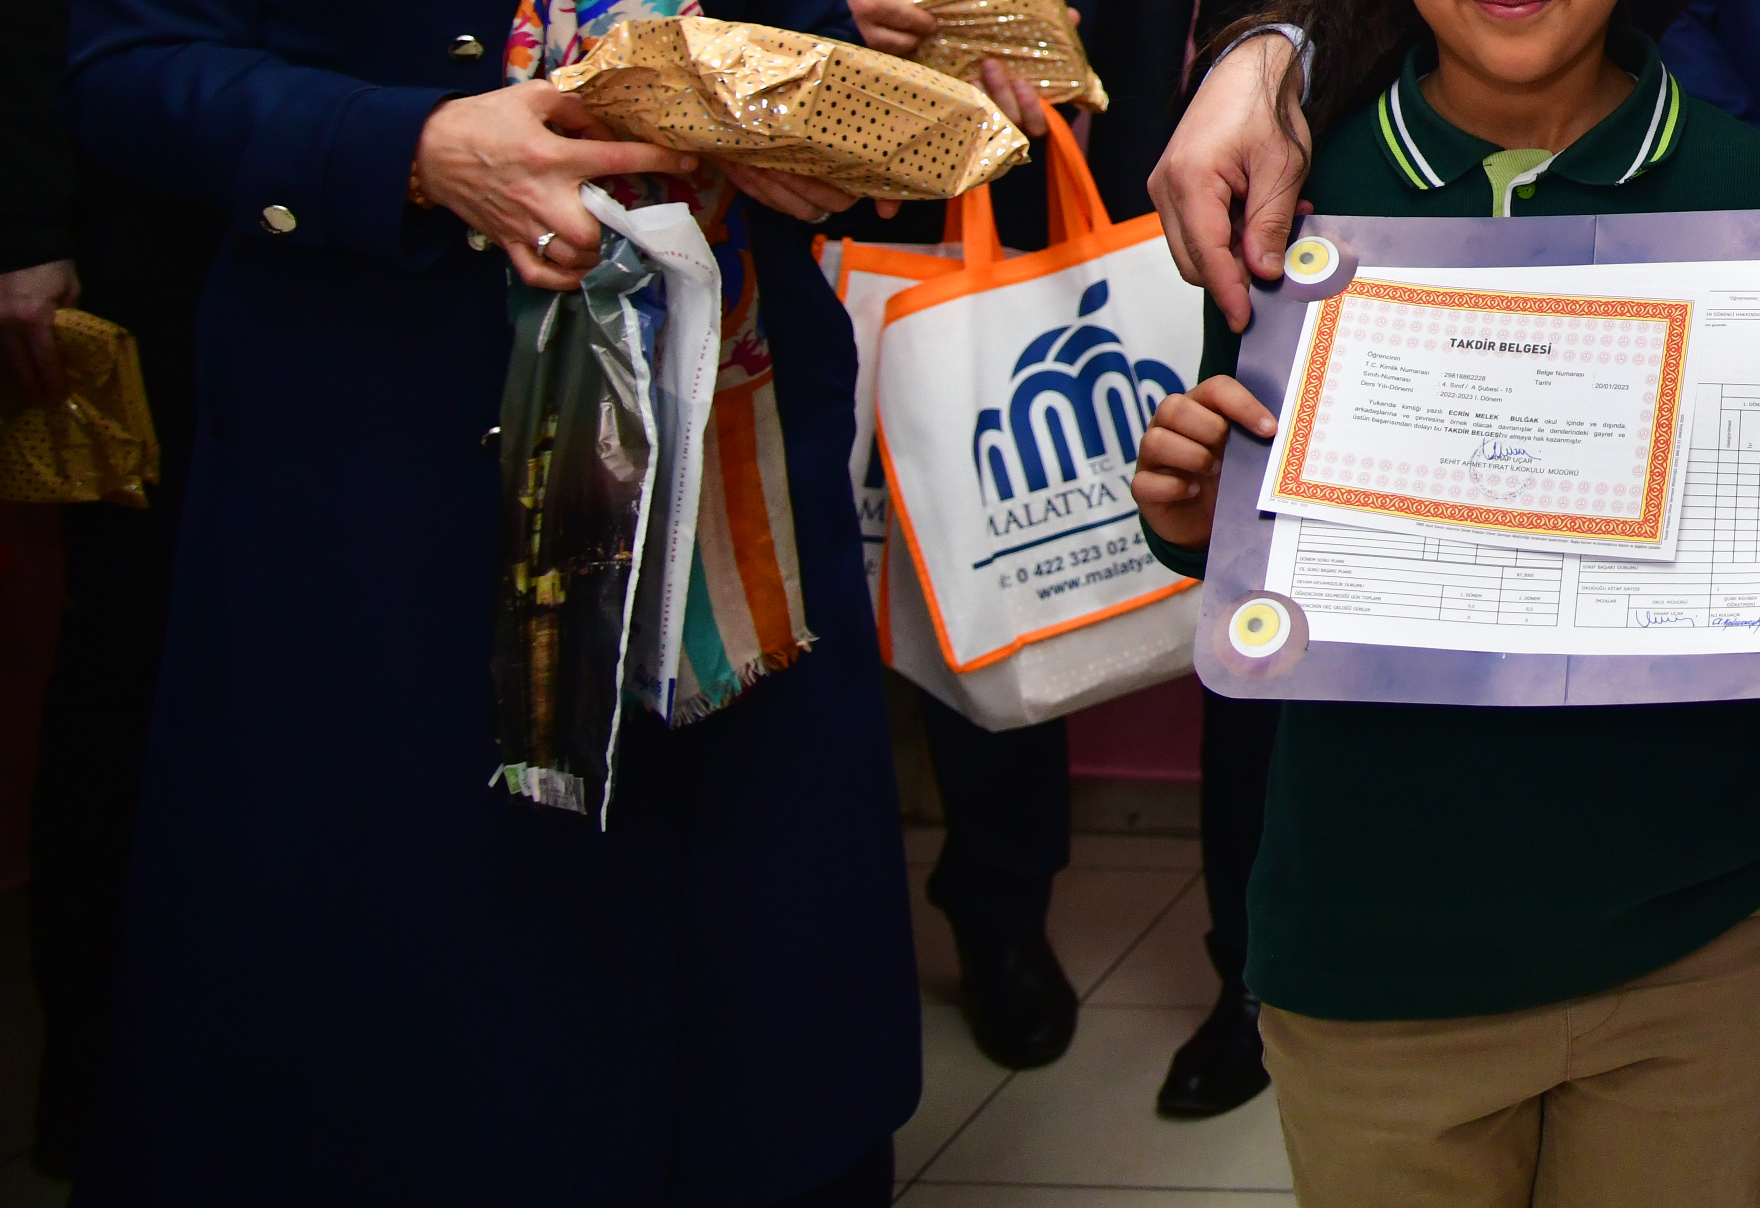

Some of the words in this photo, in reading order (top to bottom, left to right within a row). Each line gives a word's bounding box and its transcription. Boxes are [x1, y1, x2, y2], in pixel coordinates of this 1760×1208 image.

[1368, 350, 1400, 362] Öğrencinin
[1450, 338, 1496, 352] TAKDİR
[1499, 342, 1552, 355] BELGESİ
[1400, 366, 1430, 376] Numarası
[1536, 369, 1553, 377] Belge
[1555, 370, 1585, 378] Numarası
[1360, 380, 1376, 388] Ders
[1440, 392, 1473, 400] 2022-2023
[1480, 394, 1503, 403] Dönem
[1368, 398, 1396, 408] Yukarıda
[1402, 404, 1421, 412] kimliği
[1510, 415, 1539, 423] BULĞAK
[1354, 406, 1397, 417] arkadaşlarına
[1415, 416, 1444, 424] çevresine
[1450, 418, 1467, 426] örnek
[1498, 424, 1532, 433] davranışlar
[1550, 428, 1588, 436] derslerindeki
[1372, 416, 1412, 427] başarısından
[1414, 423, 1432, 431] dolayı
[1444, 426, 1469, 434] TAKDİR
[1509, 433, 1532, 441] almaya
[1546, 436, 1583, 445] kazanmıştır.
[1440, 457, 1460, 466] ŞEHİT
[1462, 460, 1486, 469] AHMET
[1489, 463, 1509, 471] FIRAT
[1510, 465, 1544, 474] İLKOKULU
[1548, 468, 1579, 476] MÜDÜRÜ
[1512, 457, 1532, 465] UÇAR
[1016, 567, 1029, 584] 0
[1034, 556, 1064, 576] 422
[1069, 544, 1101, 566] 323
[1106, 536, 1128, 556] 02
